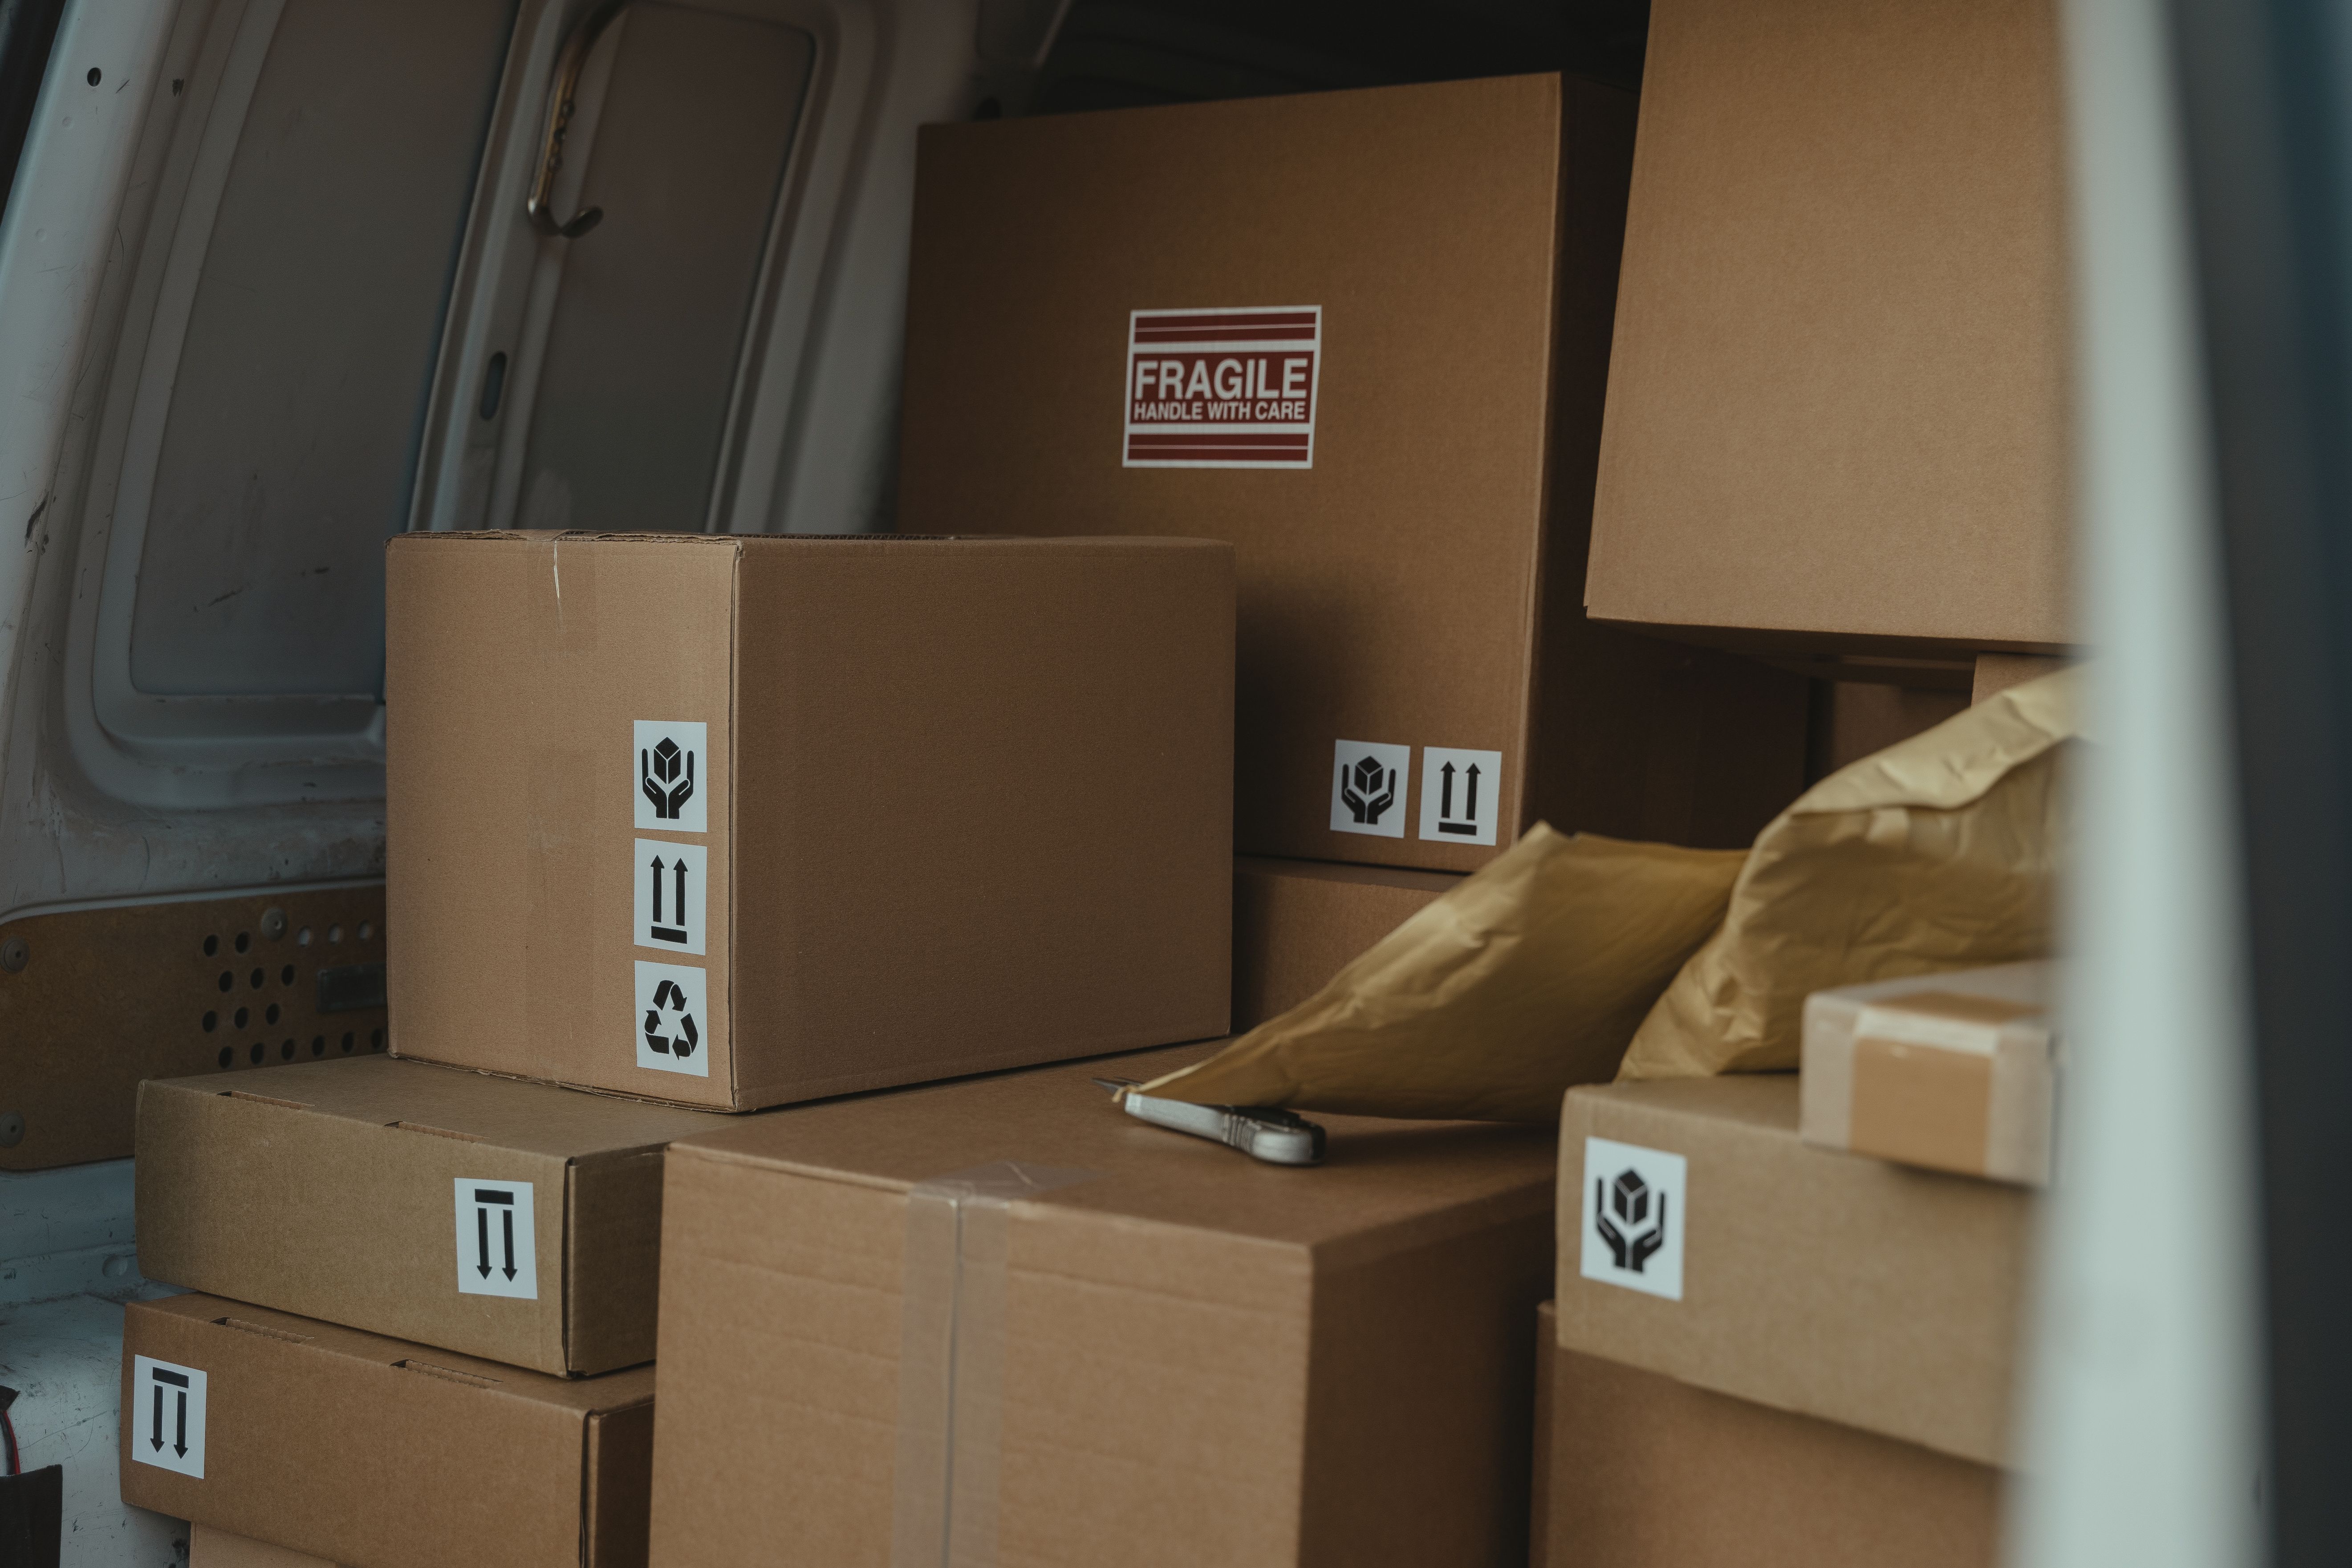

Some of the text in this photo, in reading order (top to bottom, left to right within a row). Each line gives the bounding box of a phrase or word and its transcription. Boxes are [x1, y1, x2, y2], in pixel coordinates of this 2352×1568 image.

[1135, 358, 1308, 400] FRAGILE
[1133, 400, 1305, 421] HANDLE WITH CARE
